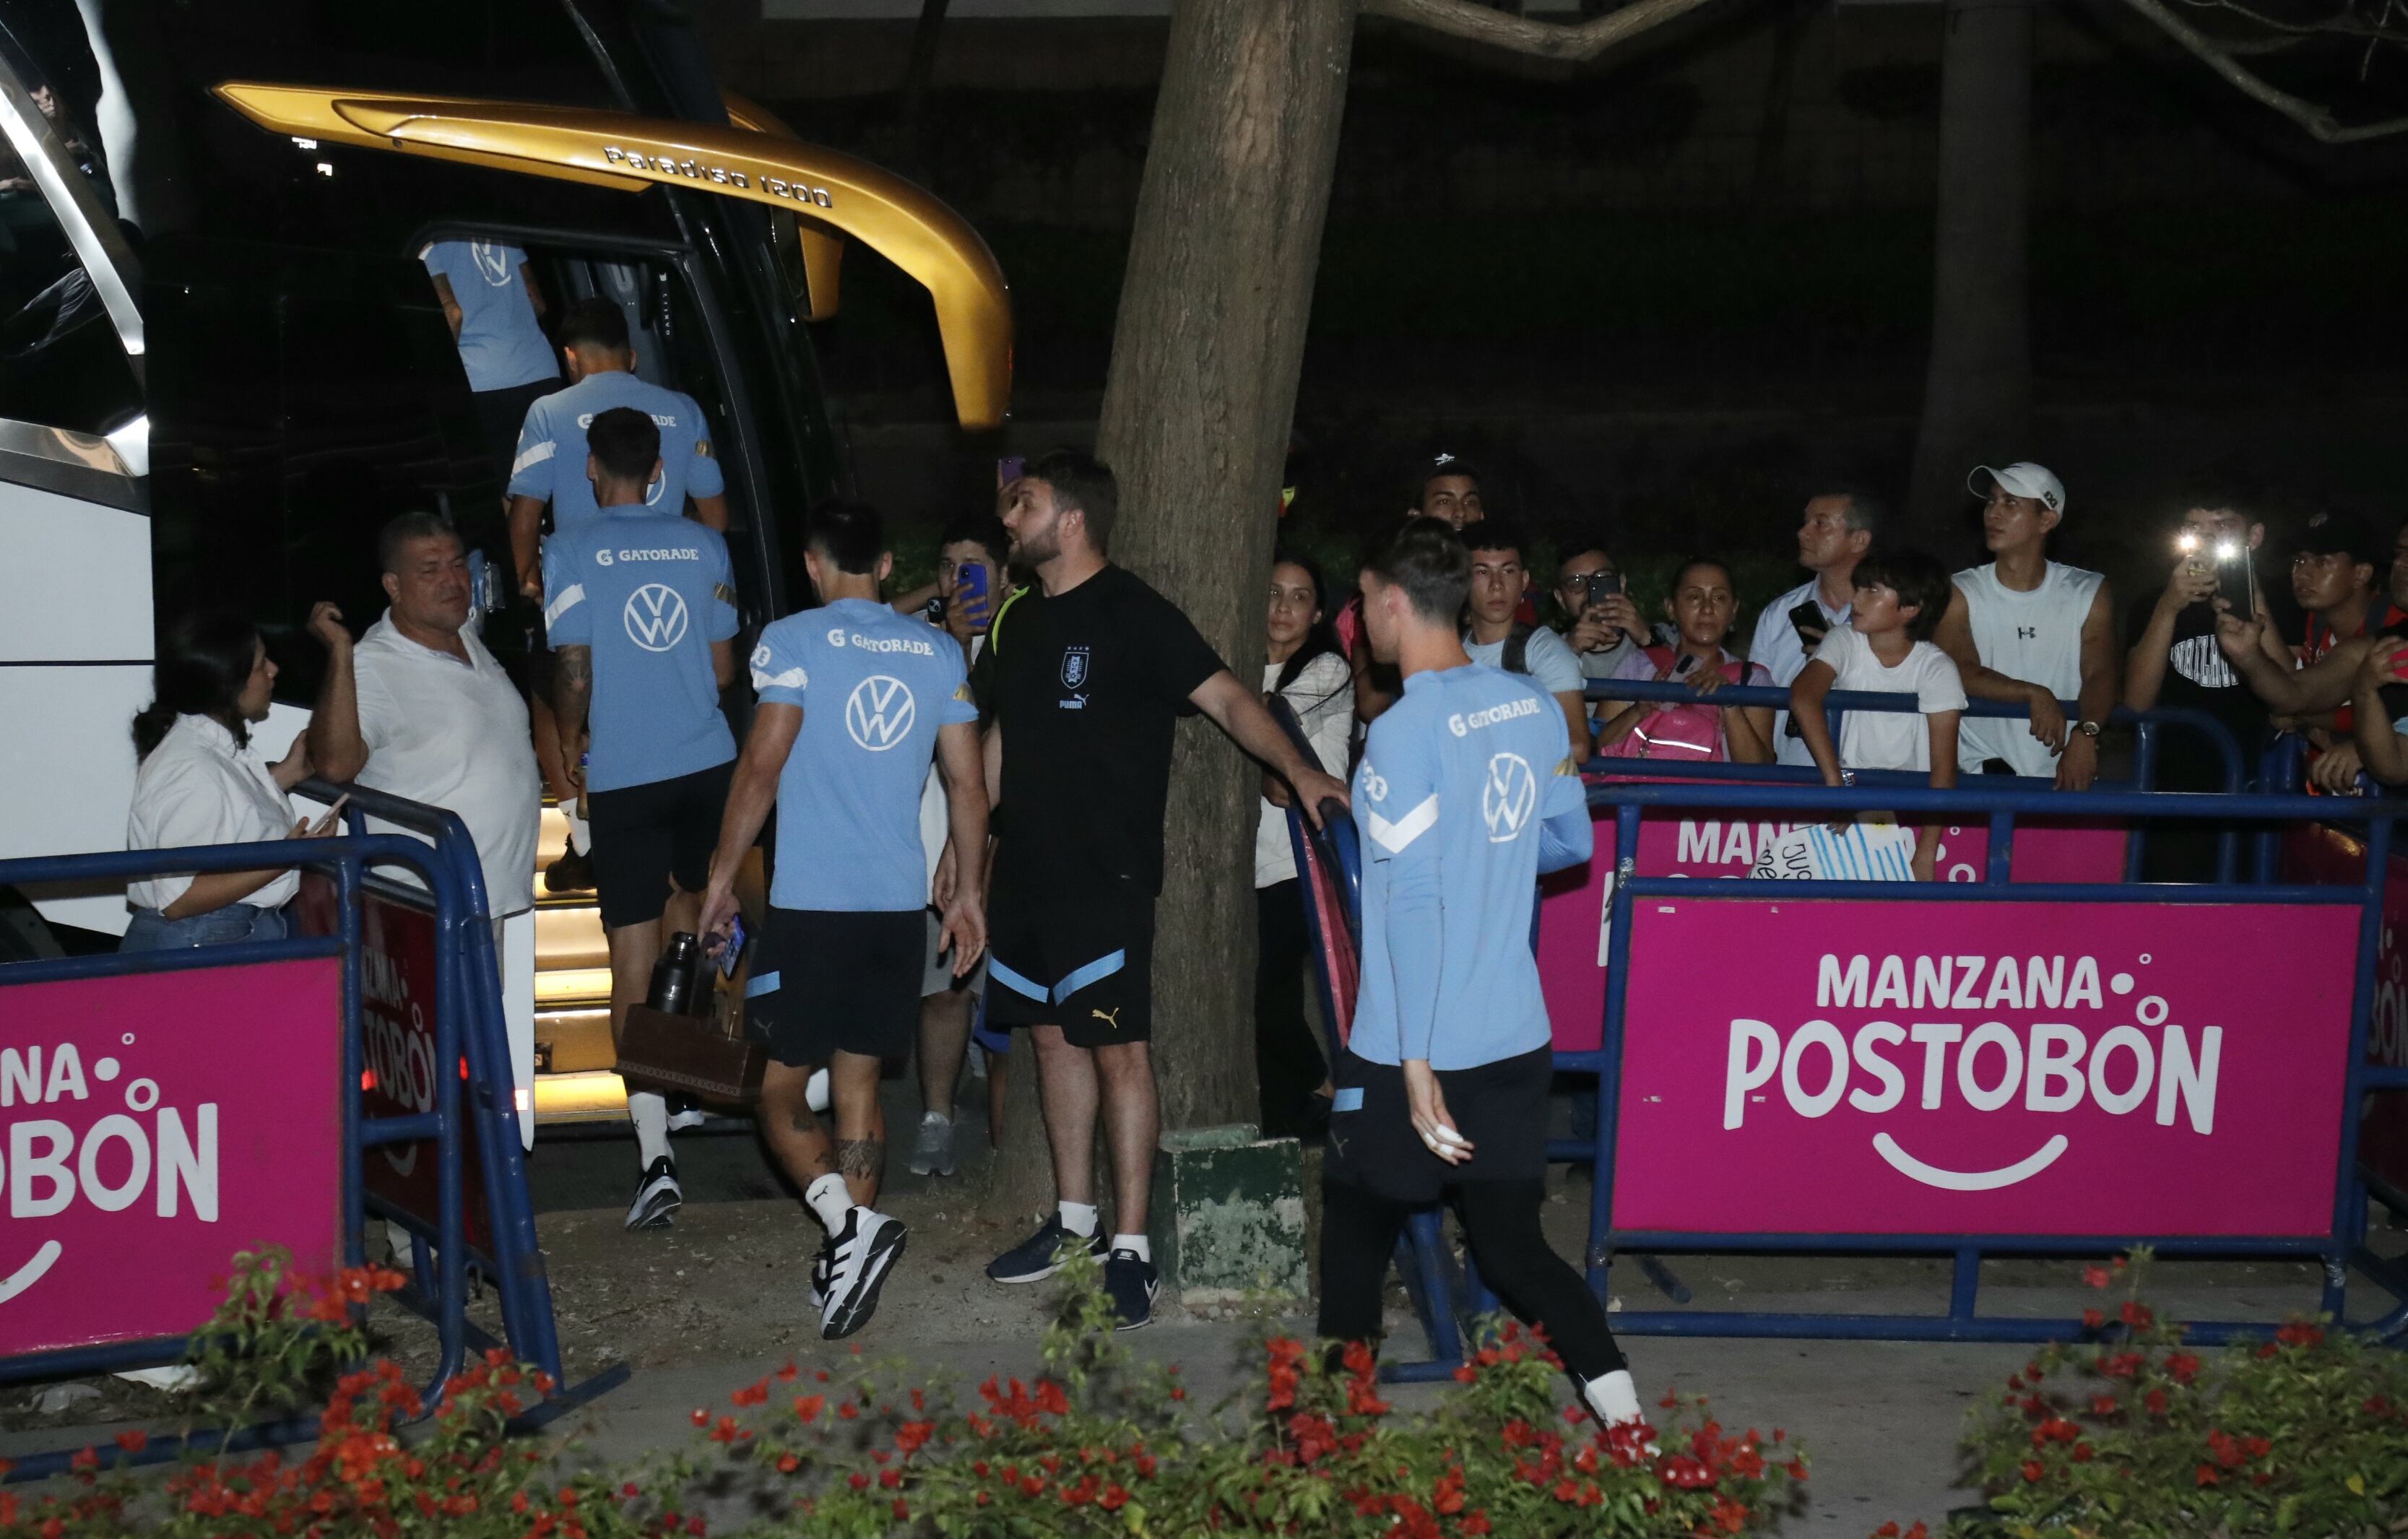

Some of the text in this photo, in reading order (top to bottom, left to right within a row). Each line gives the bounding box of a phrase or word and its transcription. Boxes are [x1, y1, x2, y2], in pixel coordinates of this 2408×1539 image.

[605, 146, 833, 208] Paradiso 1200
[618, 548, 699, 562] GATORADE
[625, 586, 686, 648] VW
[851, 633, 934, 656] GATORADE
[847, 677, 914, 747] VW
[1059, 700, 1083, 709] PUMA
[1816, 953, 2103, 1009] MANZANA
[1723, 1018, 2223, 1135] POSTOBON
[0, 1103, 218, 1222] BON
